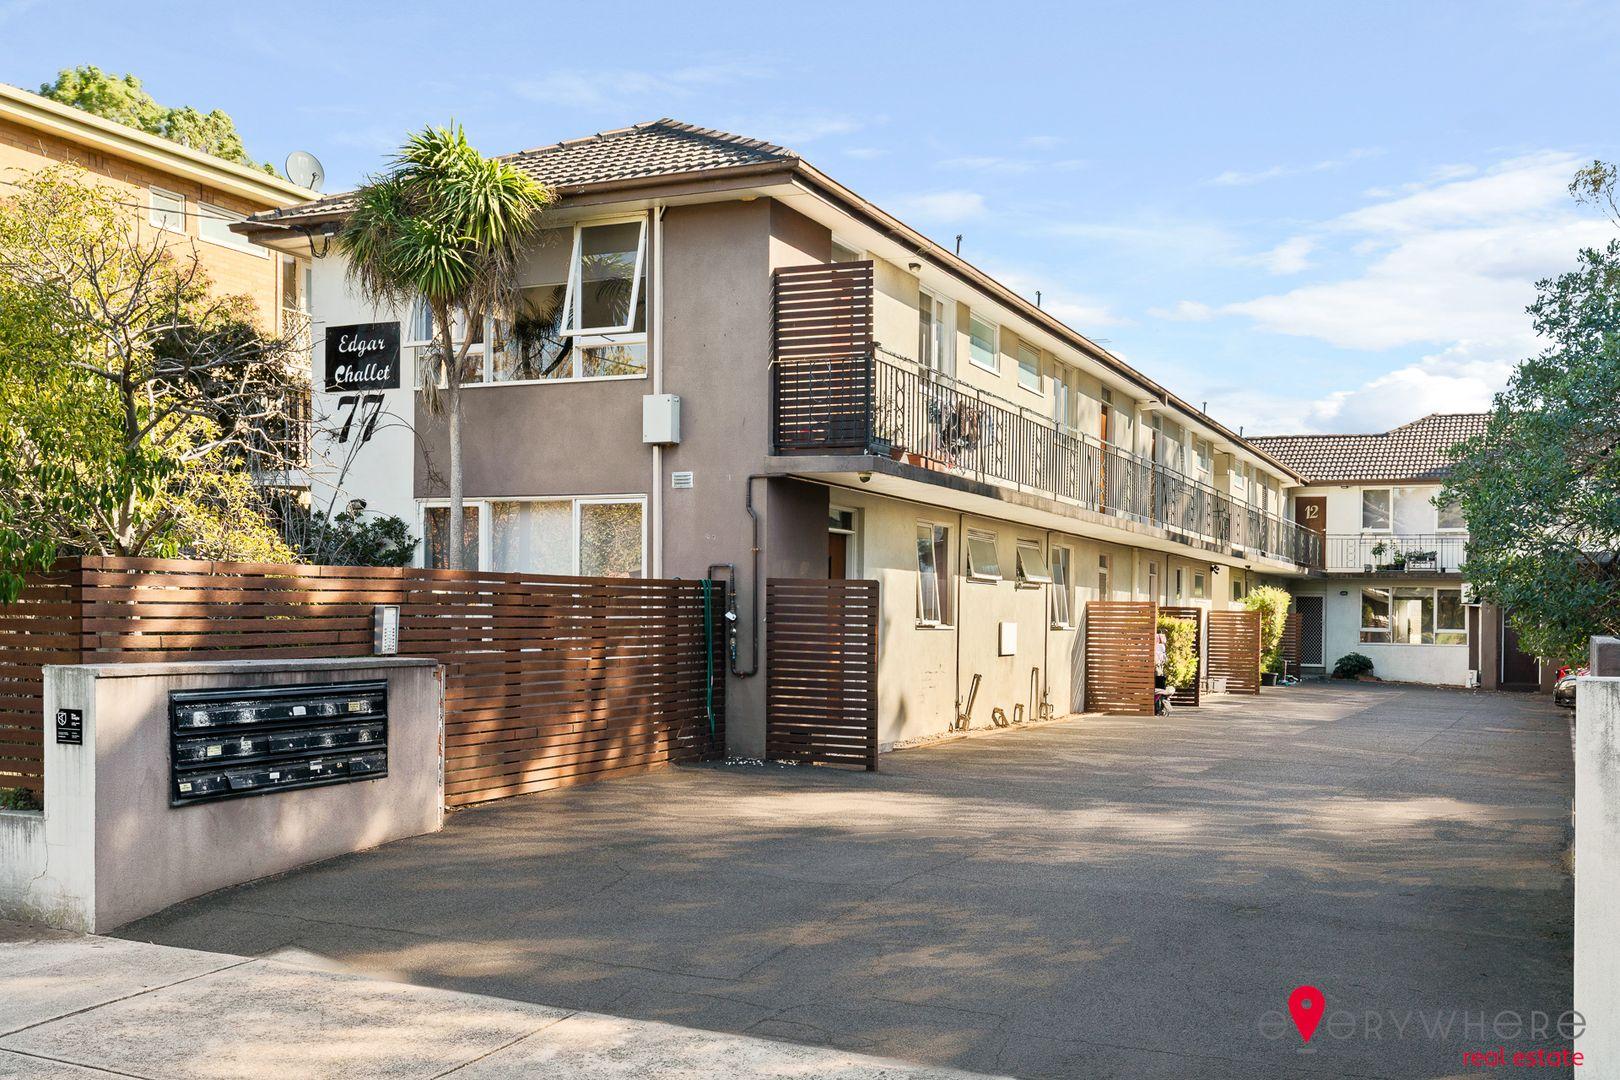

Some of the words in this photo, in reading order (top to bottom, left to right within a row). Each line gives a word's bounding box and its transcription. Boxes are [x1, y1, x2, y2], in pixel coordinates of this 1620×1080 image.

[338, 333, 386, 358] Edgar
[334, 362, 391, 384] Challet
[337, 393, 386, 444] 77
[1304, 504, 1319, 520] 12
